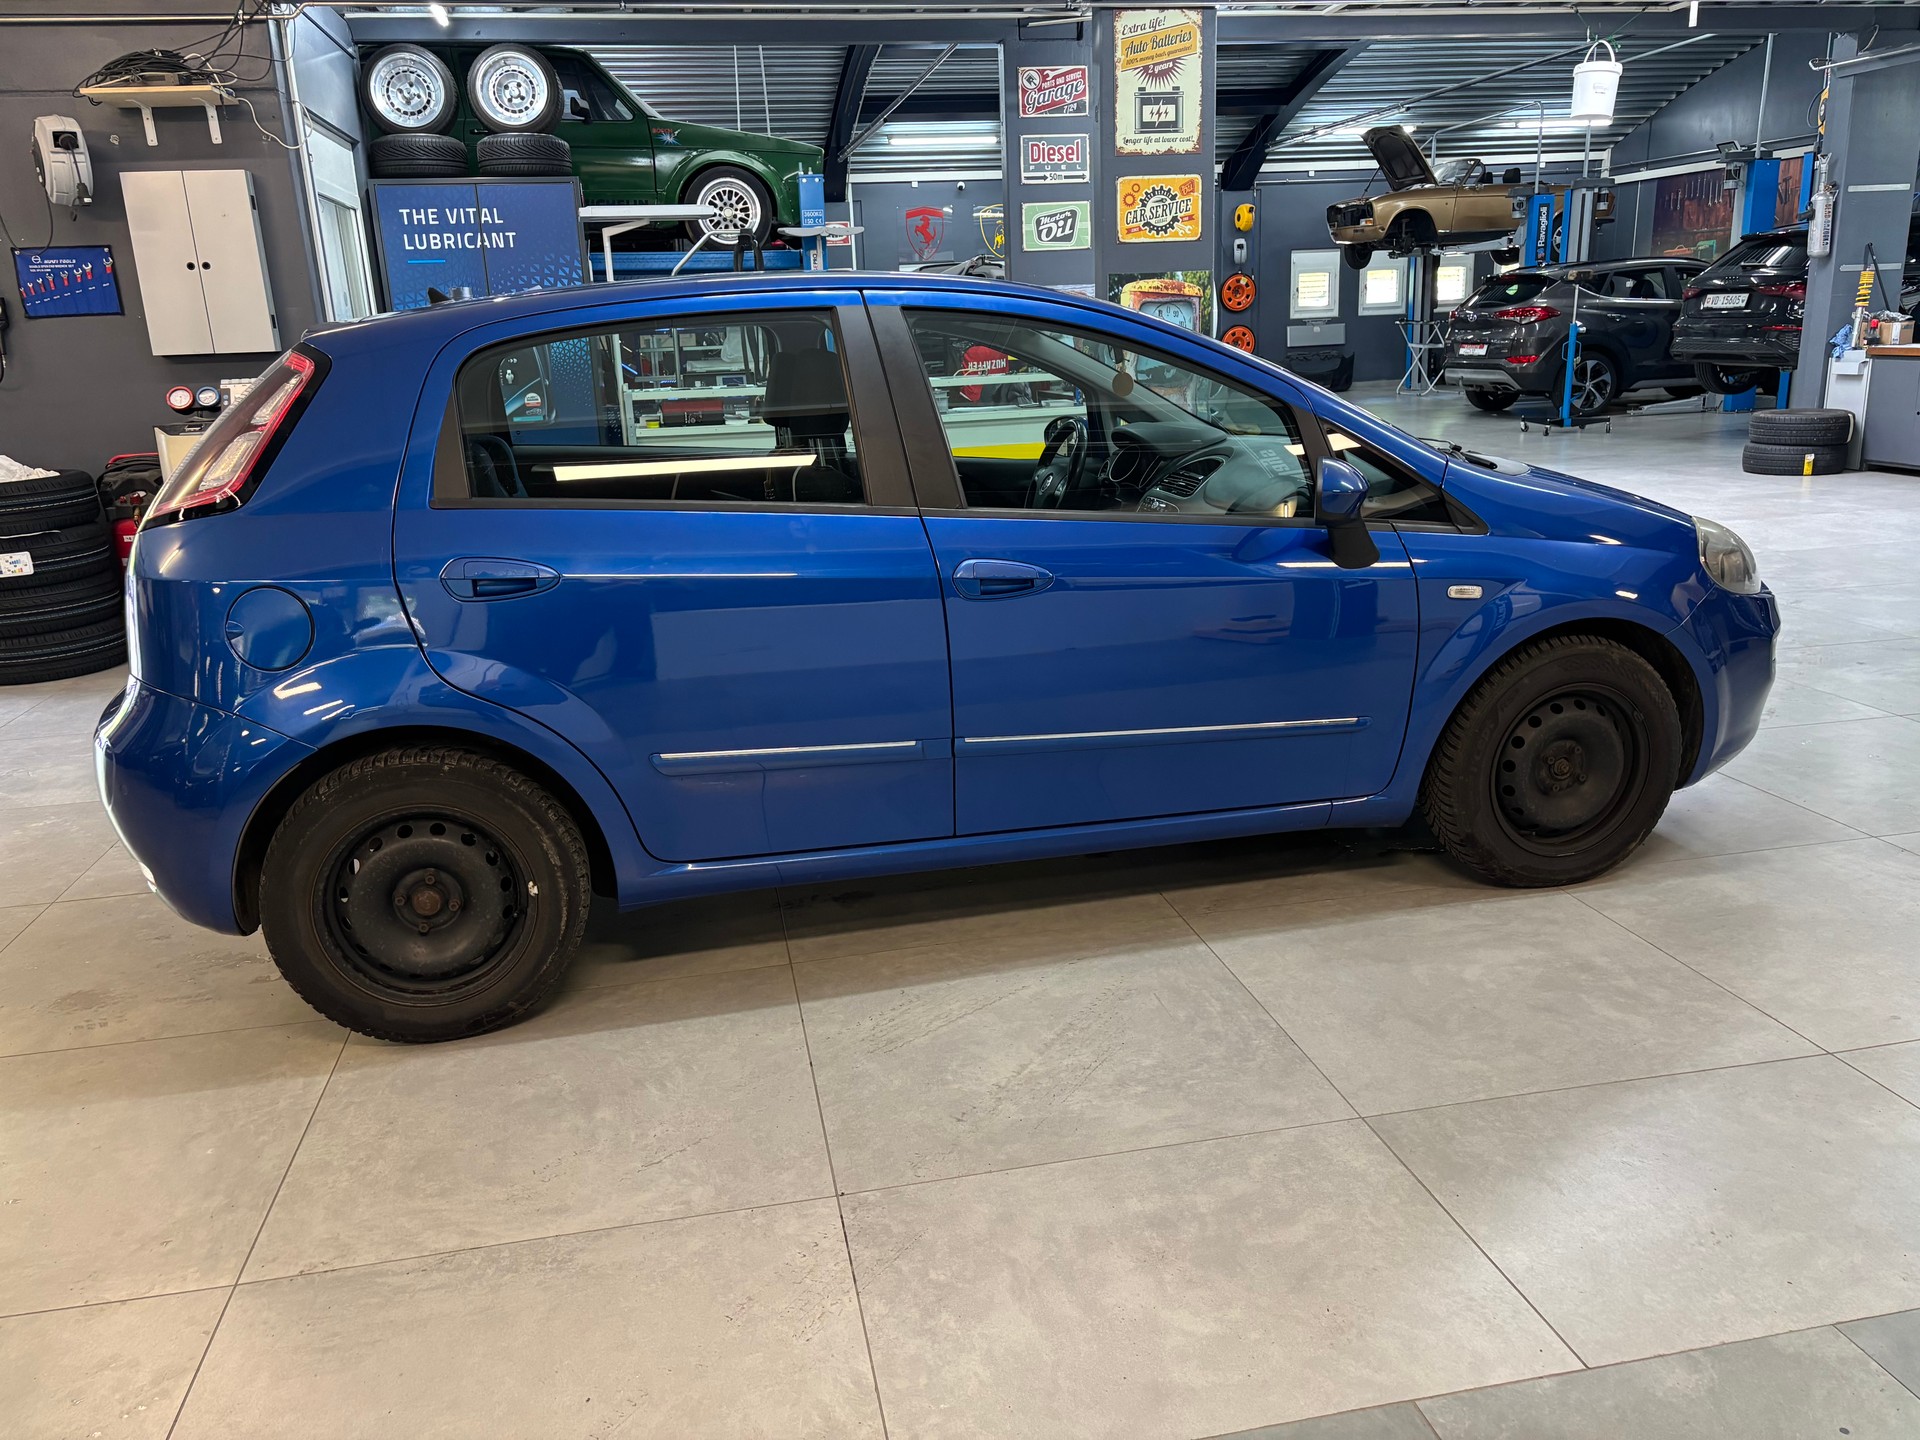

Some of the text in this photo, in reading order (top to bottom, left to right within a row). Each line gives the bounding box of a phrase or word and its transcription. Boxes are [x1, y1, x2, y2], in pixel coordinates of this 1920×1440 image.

[1122, 16, 1166, 36] Extra life!
[1125, 30, 1192, 58] Auto Batteries
[1139, 54, 1154, 63] money
[1148, 61, 1174, 74] 2 years
[1042, 71, 1082, 90] PARTS AND SERVICE
[1025, 79, 1085, 114] Garage
[1123, 136, 1141, 145] Longer
[1144, 136, 1153, 145] life
[1029, 139, 1081, 164] Diesel
[1049, 172, 1063, 181] 50m
[399, 207, 504, 225] THE VITAL
[1040, 211, 1072, 226] Motor
[1125, 198, 1192, 225] CAR SERVICE
[1038, 218, 1073, 242] Oil
[1537, 206, 1549, 247] Ravaglioli
[403, 231, 517, 251] LUBRICANT
